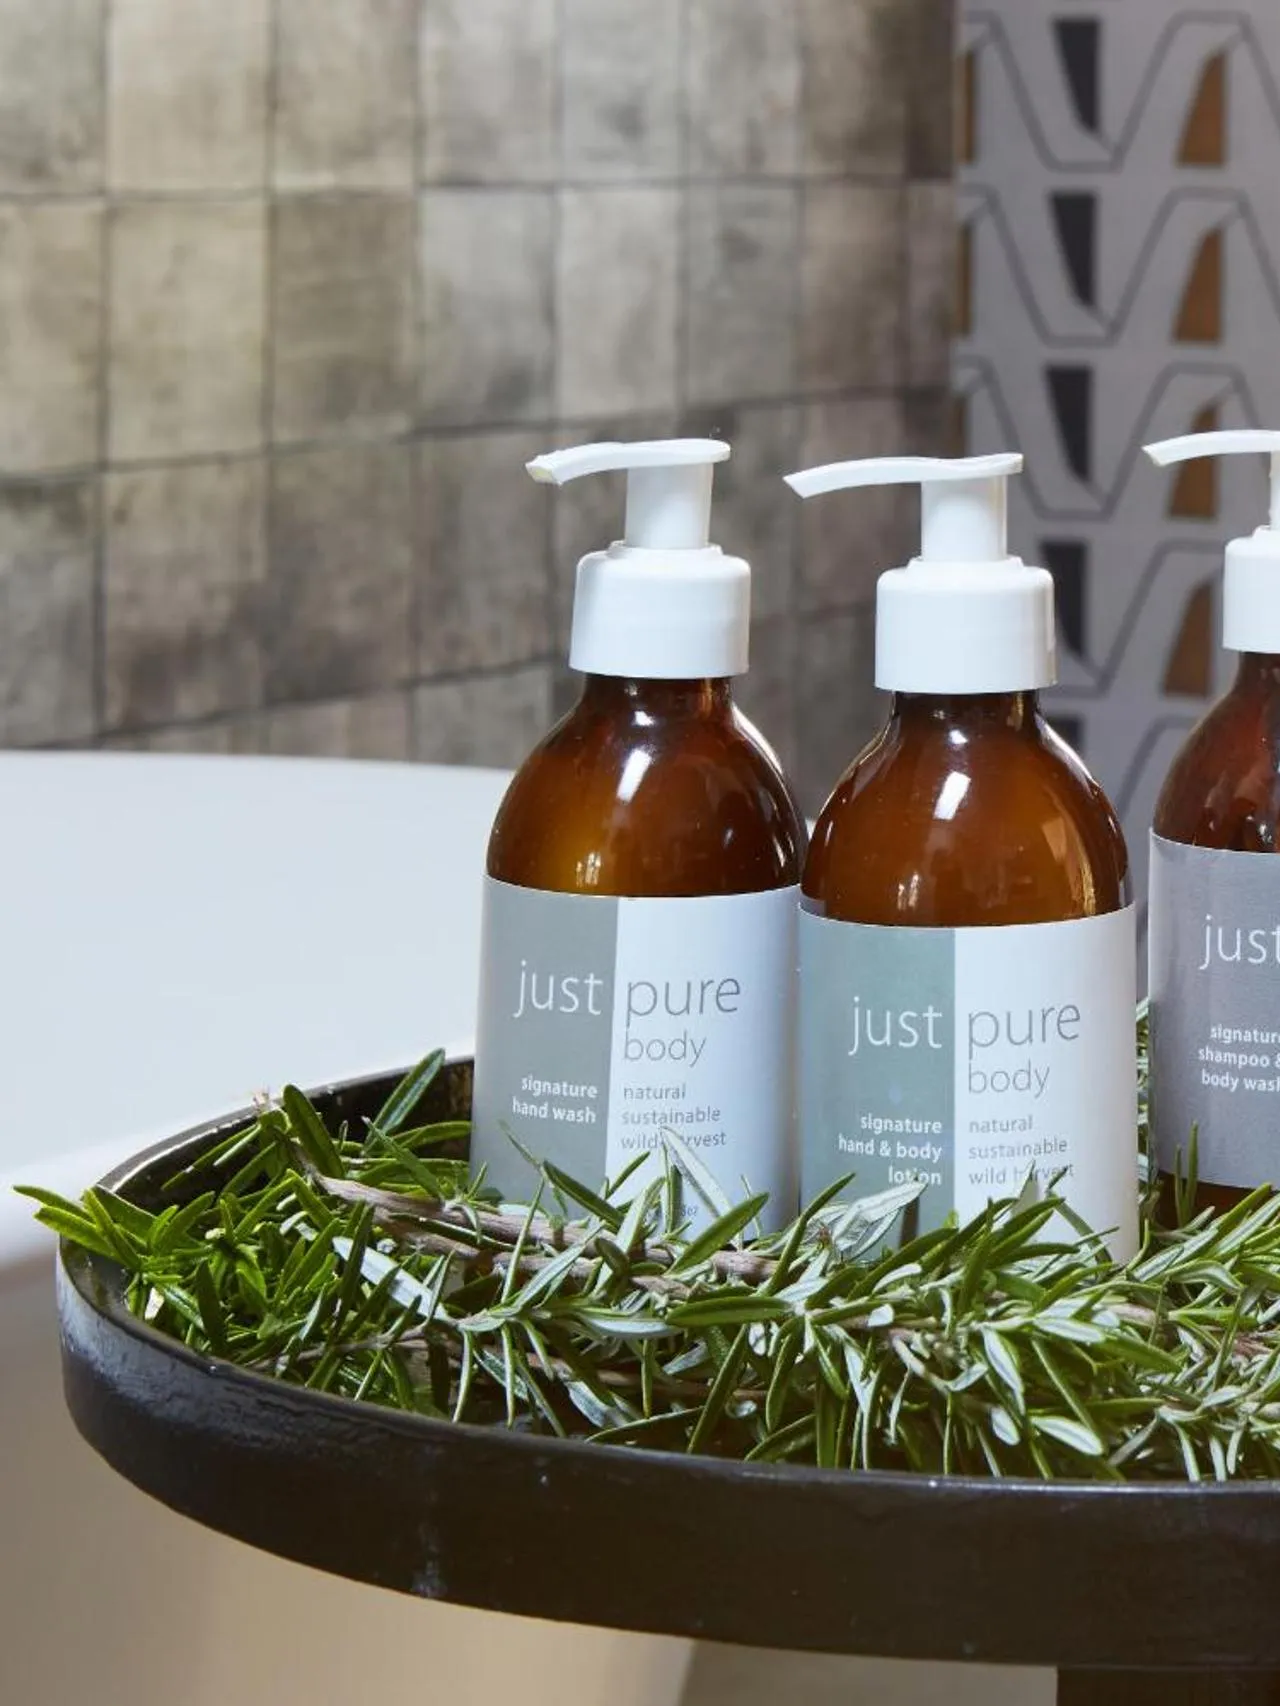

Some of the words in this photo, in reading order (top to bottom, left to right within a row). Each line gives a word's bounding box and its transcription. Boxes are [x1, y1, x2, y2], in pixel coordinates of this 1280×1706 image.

[512, 960, 604, 1018] just
[625, 977, 742, 1029] pure
[848, 996, 943, 1056] just
[967, 1004, 1081, 1059] pure
[623, 1030, 707, 1068] body
[1198, 1045, 1270, 1070] shampoo
[521, 1074, 598, 1098] signature
[967, 1060, 1051, 1098] body
[1201, 1068, 1240, 1093] body
[623, 1083, 686, 1100] natural
[511, 1095, 549, 1119] hand
[552, 1106, 597, 1123] wash
[620, 1105, 721, 1125] sustainable
[860, 1112, 943, 1135] signature
[969, 1114, 1033, 1133] natural
[620, 1133, 659, 1149] wild
[670, 1131, 727, 1149] rvest
[838, 1132, 875, 1155] hand
[879, 1140, 892, 1157] &
[896, 1141, 943, 1164] body
[968, 1137, 1068, 1159] sustainable
[968, 1166, 1006, 1184] wild
